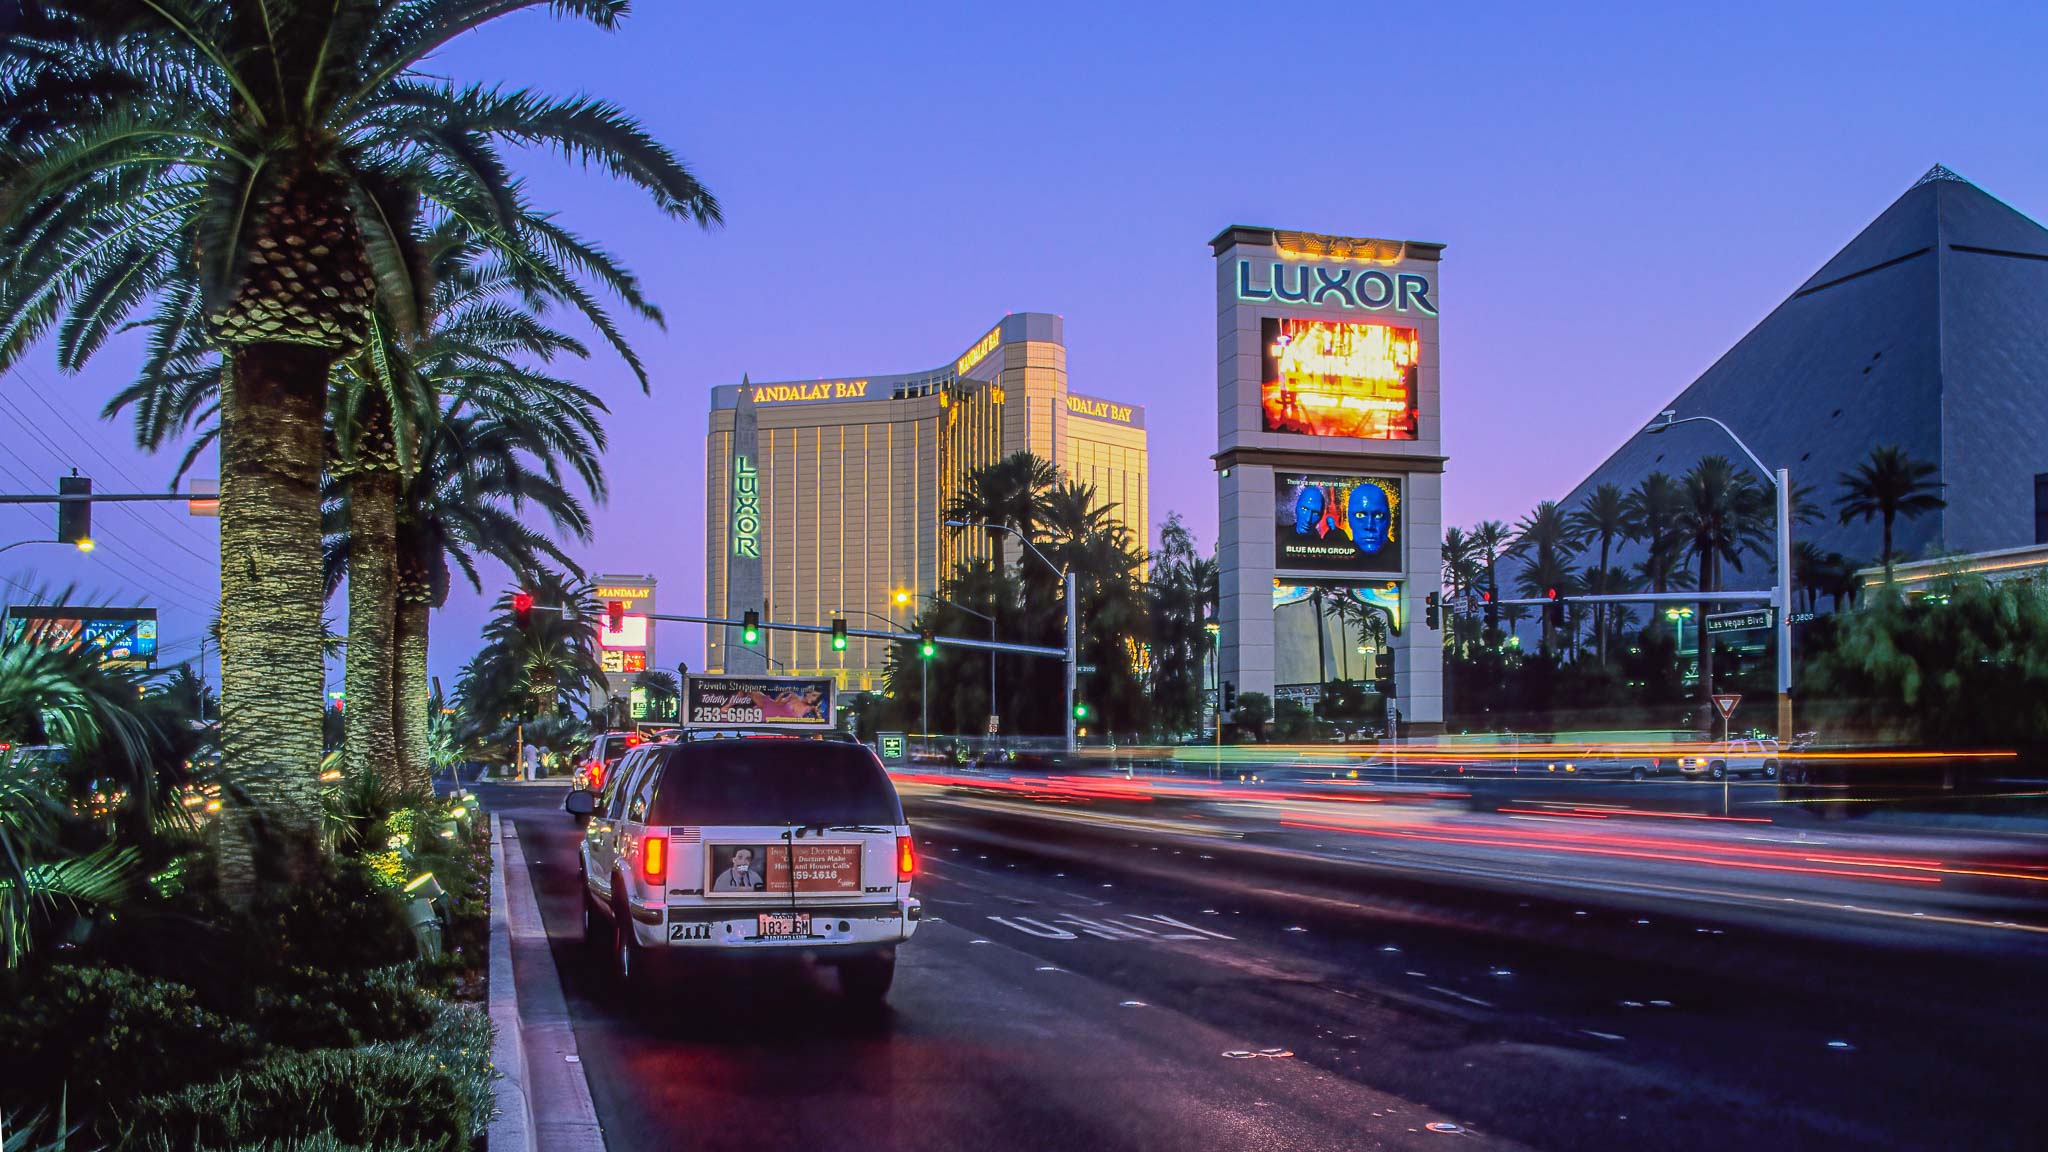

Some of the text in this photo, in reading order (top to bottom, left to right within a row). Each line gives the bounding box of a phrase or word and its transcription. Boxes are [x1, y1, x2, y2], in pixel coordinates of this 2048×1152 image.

[1237, 259, 1441, 317] LUXOR
[752, 380, 868, 403] ANDALAY BAY
[1066, 396, 1133, 423] NDALAY BAY
[735, 455, 760, 558] LUXOR
[1286, 545, 1356, 555] BLUE MAN GROUP
[598, 587, 650, 599] MANDALAY
[1708, 620, 1723, 630] Las
[698, 680, 727, 691] Private
[729, 681, 767, 693] Strippers
[702, 694, 752, 706] Totally Nude
[694, 707, 763, 723] 253-6969
